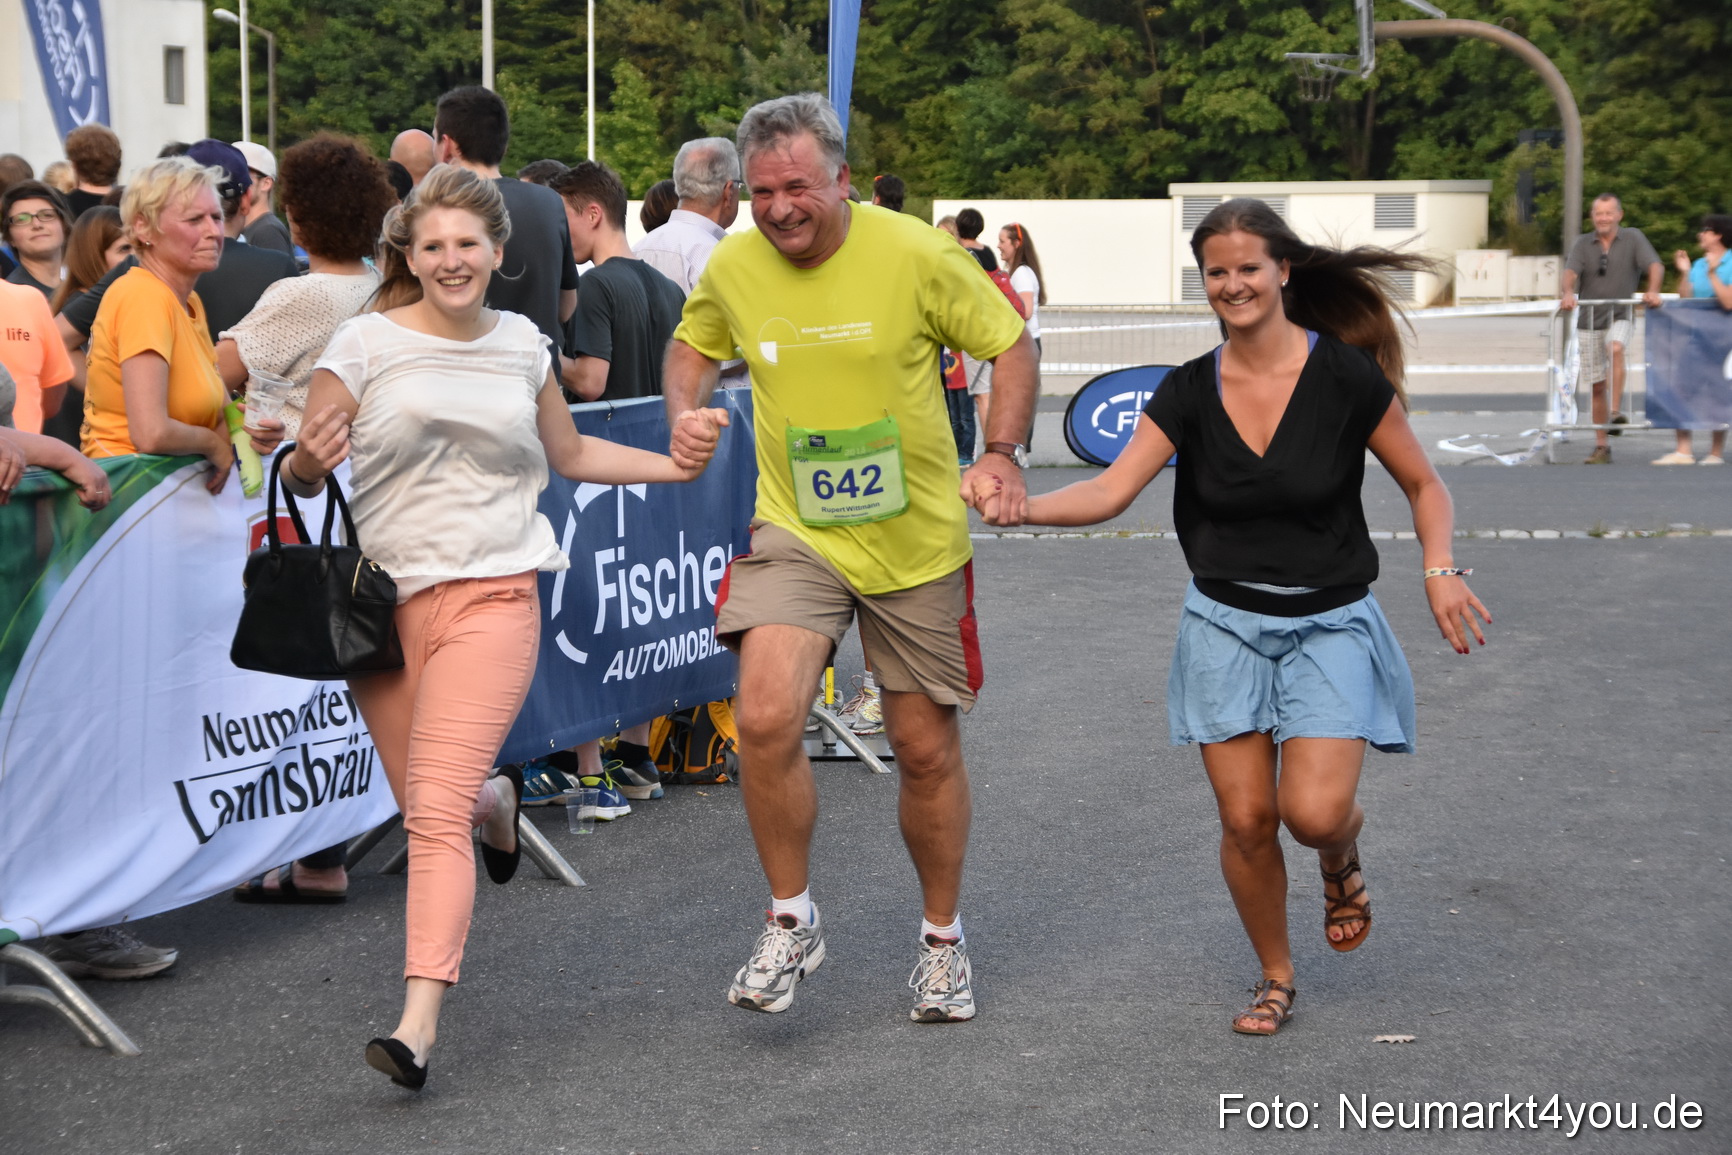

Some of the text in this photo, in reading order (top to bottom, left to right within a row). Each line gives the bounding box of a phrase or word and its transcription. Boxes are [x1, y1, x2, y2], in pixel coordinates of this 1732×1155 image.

[6, 327, 30, 341] life
[819, 331, 850, 339] Neumarkt
[812, 464, 884, 500] 642
[846, 502, 880, 512] Wittmann
[593, 530, 733, 635] Fische
